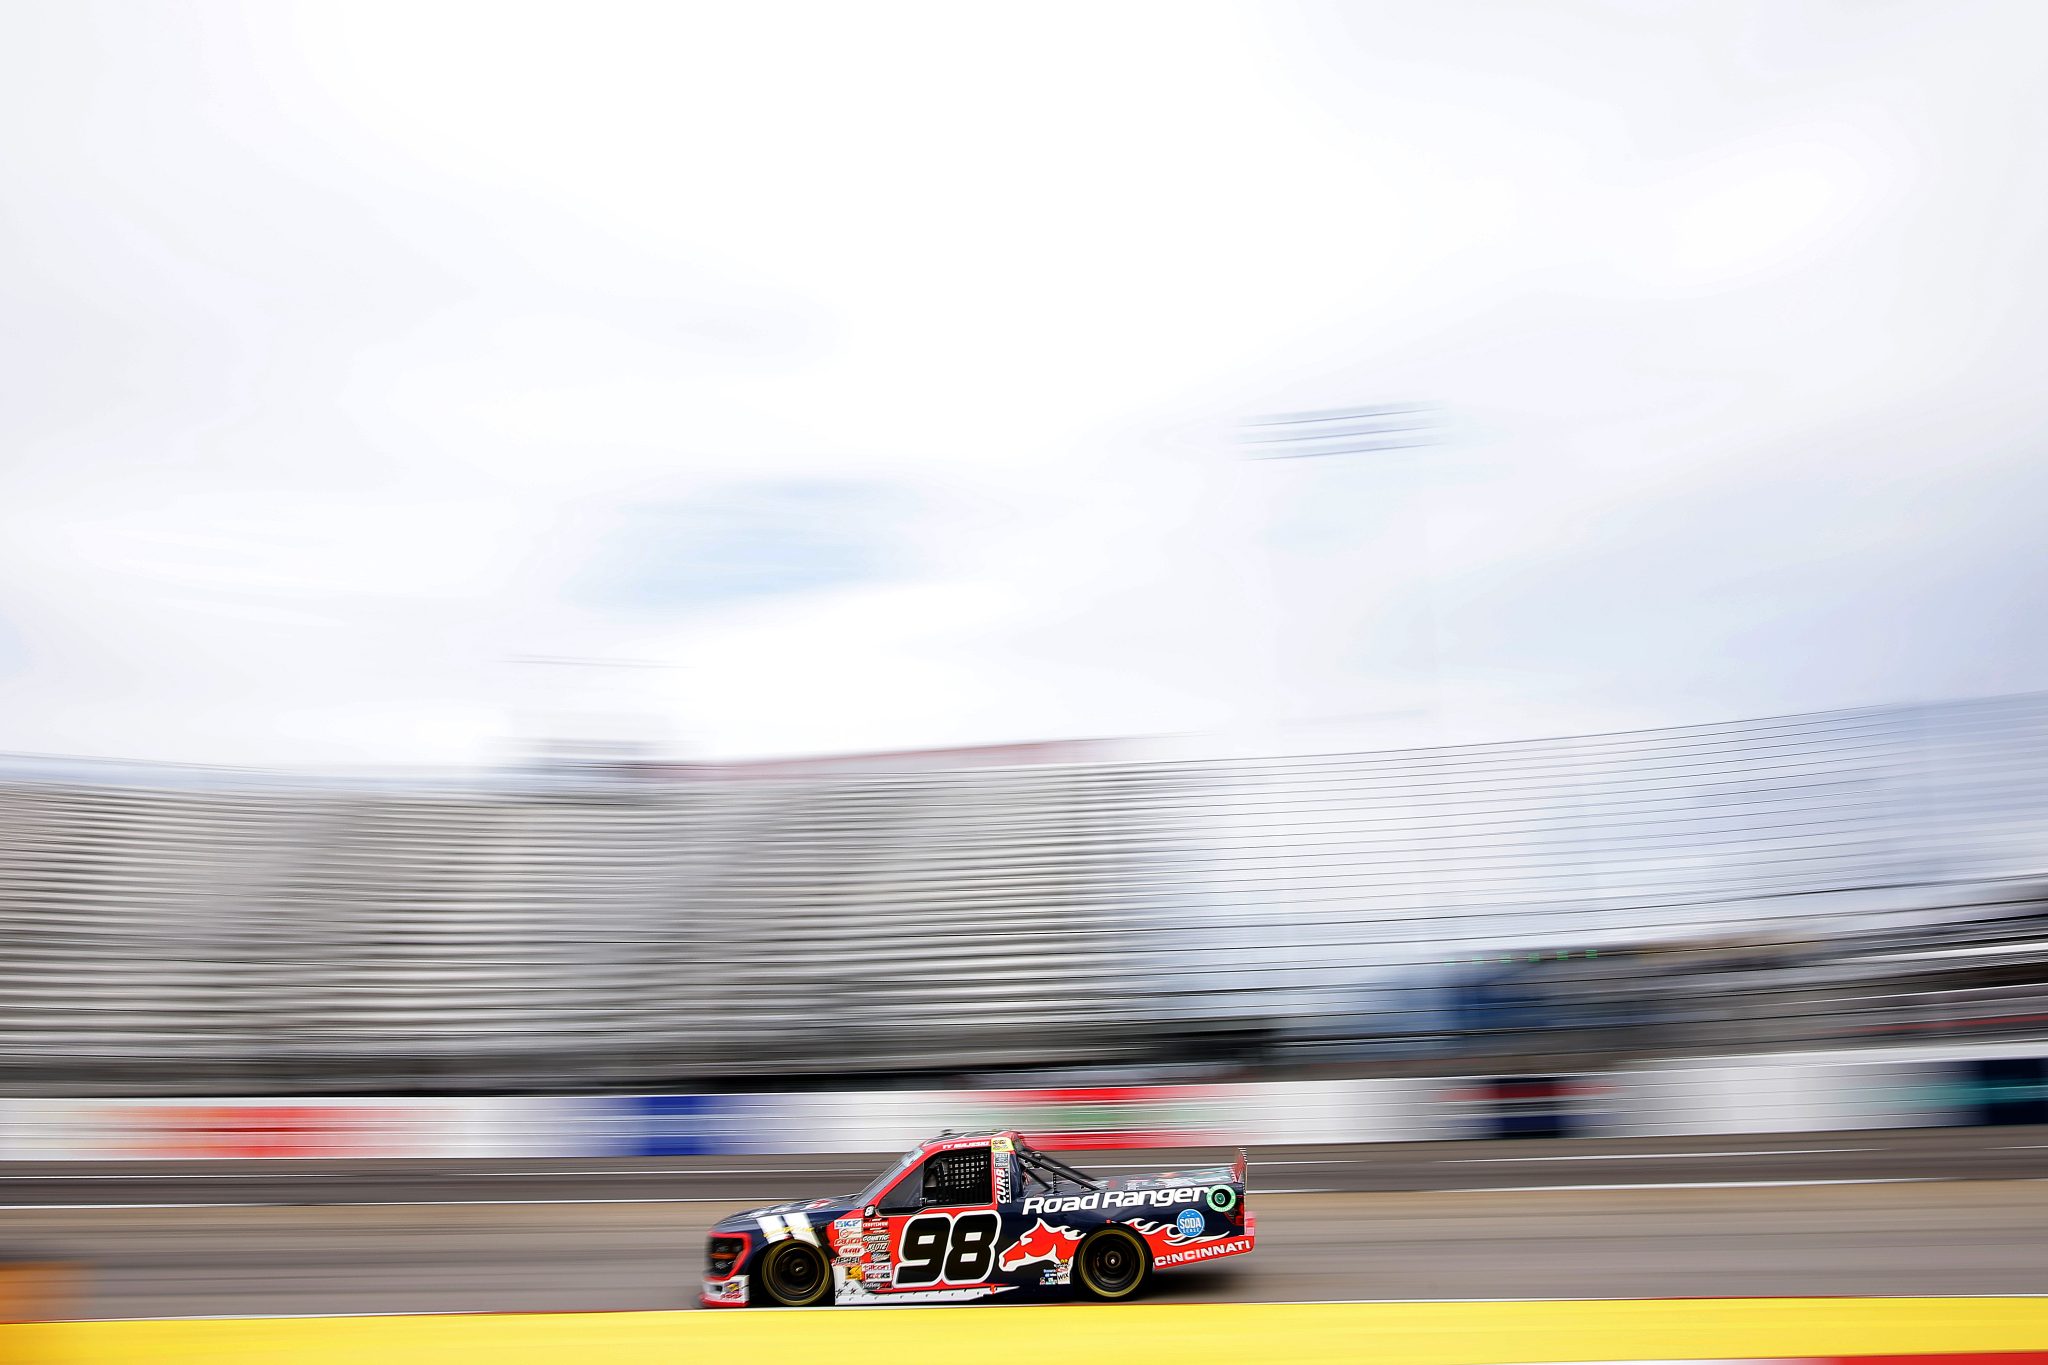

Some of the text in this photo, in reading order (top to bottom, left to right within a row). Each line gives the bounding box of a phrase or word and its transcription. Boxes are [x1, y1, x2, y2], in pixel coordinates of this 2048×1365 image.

[996, 1168, 1006, 1204] CURB
[1022, 1186, 1208, 1215] Road Ranger
[835, 1220, 861, 1228] SKF
[1179, 1218, 1202, 1229] SODA
[894, 1210, 1001, 1286] 98
[1154, 1240, 1251, 1268] CINCINNATI
